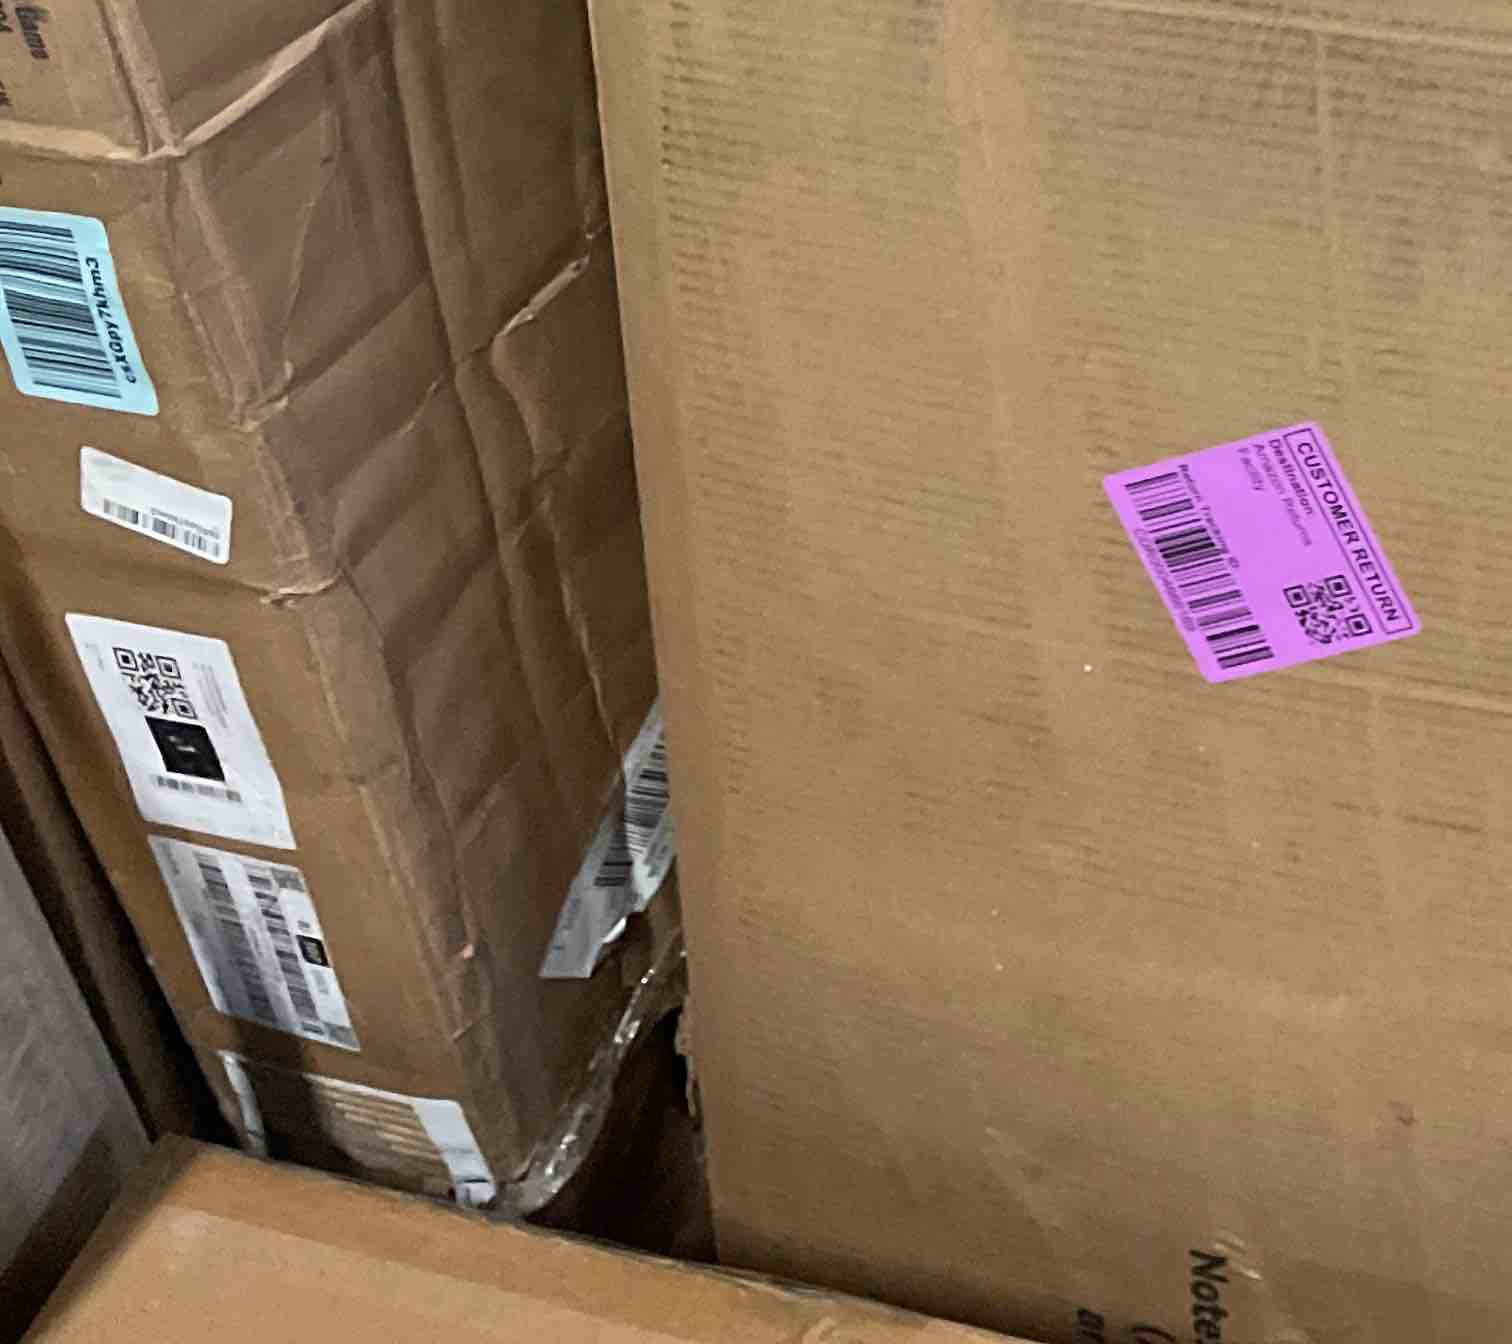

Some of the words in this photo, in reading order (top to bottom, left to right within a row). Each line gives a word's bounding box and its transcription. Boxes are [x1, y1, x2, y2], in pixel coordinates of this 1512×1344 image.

[1269, 438, 1314, 515] Destination
[1297, 441, 1359, 545] CUSTOMER
[1352, 547, 1400, 622] RETURN
